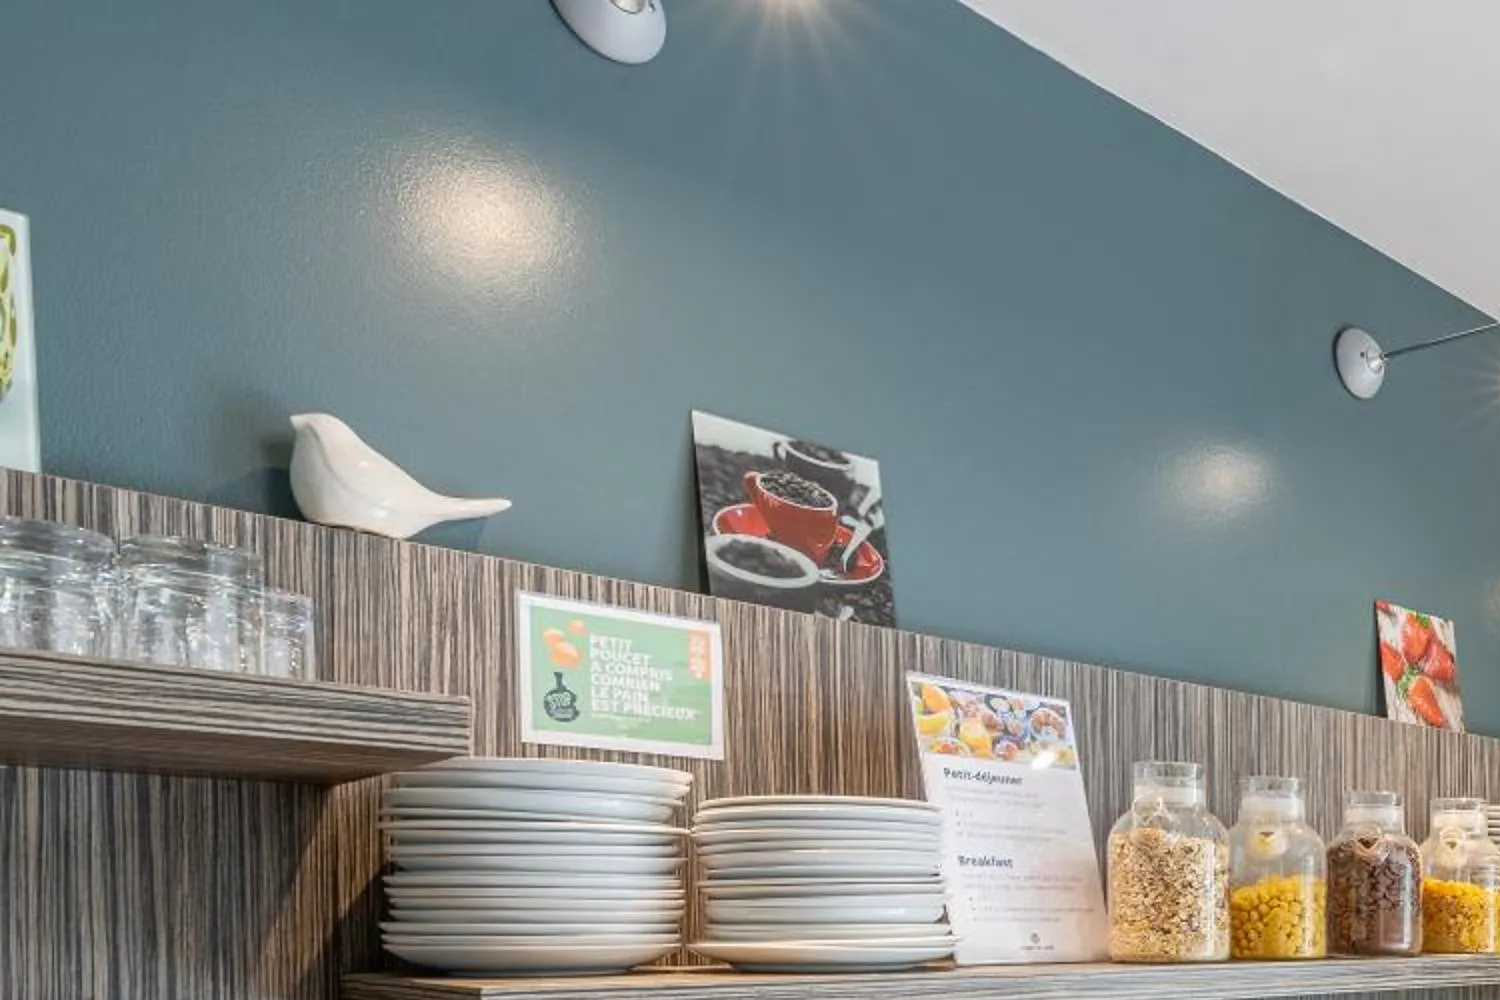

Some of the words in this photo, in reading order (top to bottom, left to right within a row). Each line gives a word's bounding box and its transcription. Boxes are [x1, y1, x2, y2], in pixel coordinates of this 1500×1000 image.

[590, 634, 632, 651] PETIT
[590, 648, 652, 667] POUCET
[606, 663, 673, 681] COMPRIS
[592, 674, 661, 692] COMBIEN
[591, 687, 609, 699] LE
[613, 687, 649, 704] PAIN
[957, 855, 1013, 868] Breakfast
